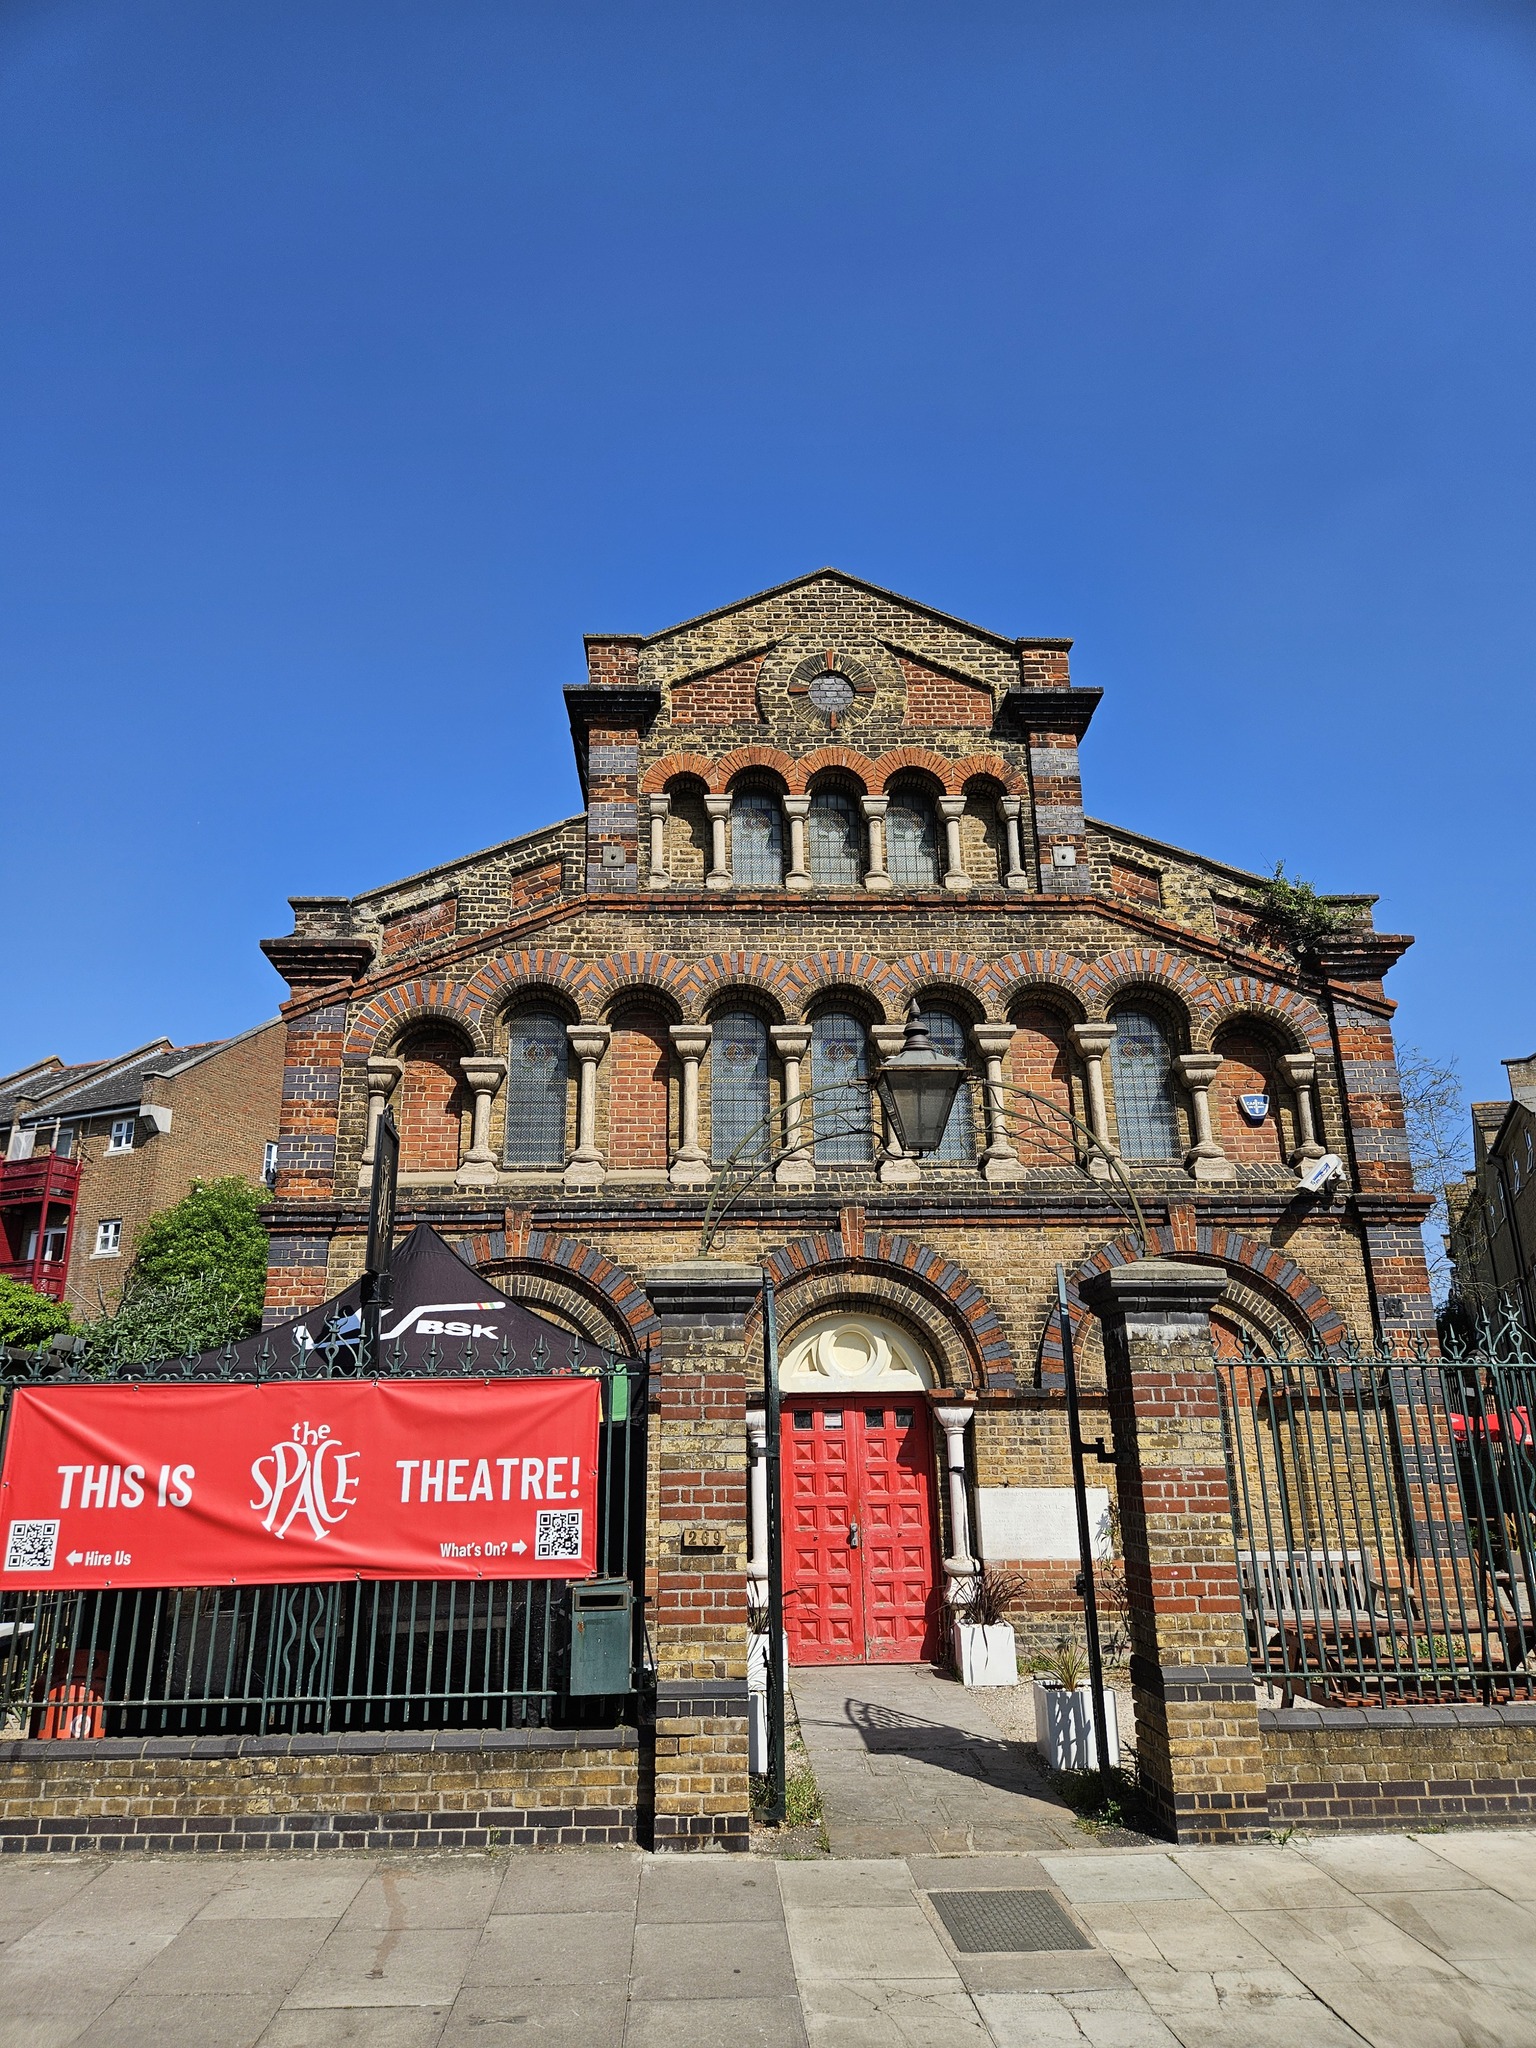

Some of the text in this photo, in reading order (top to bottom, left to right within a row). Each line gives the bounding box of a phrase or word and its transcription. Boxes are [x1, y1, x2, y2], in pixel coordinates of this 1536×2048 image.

[415, 1319, 499, 1340] BSK
[291, 1421, 331, 1445] the
[57, 1464, 195, 1508] THIS IS
[249, 1440, 361, 1541] SPACE
[396, 1456, 580, 1503] THEATRE!
[688, 1530, 721, 1546] 269
[84, 1550, 132, 1566] Hire Us
[440, 1541, 508, 1558] What's On?
